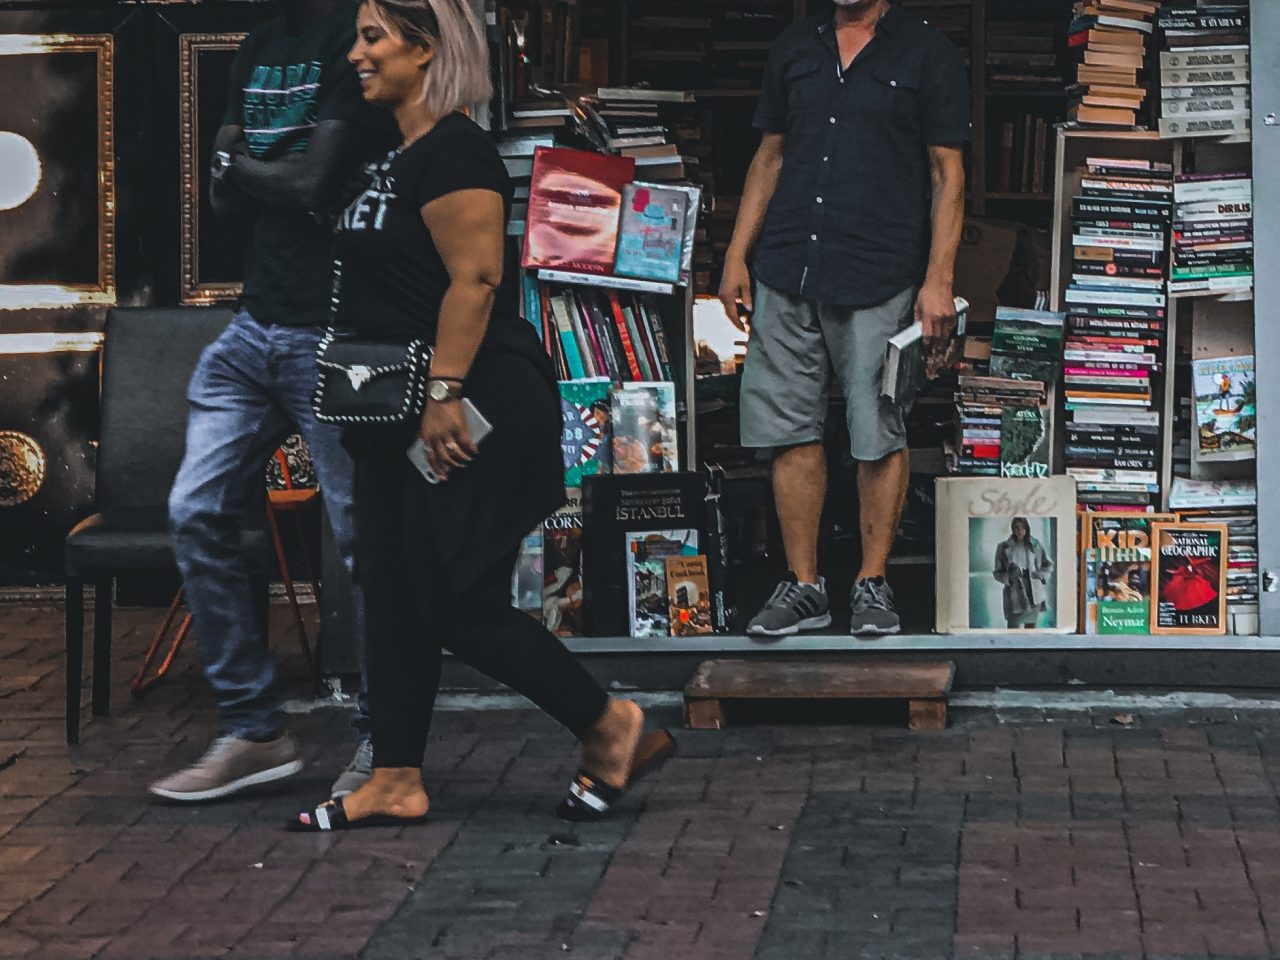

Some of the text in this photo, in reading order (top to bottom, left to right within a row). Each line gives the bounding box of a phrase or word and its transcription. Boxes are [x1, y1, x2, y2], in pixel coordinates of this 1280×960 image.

[968, 483, 1058, 517] Style
[1161, 546, 1219, 558] GEOGRAPHIC
[1102, 616, 1145, 631] Neymar
[1179, 614, 1218, 625] TURKEY
